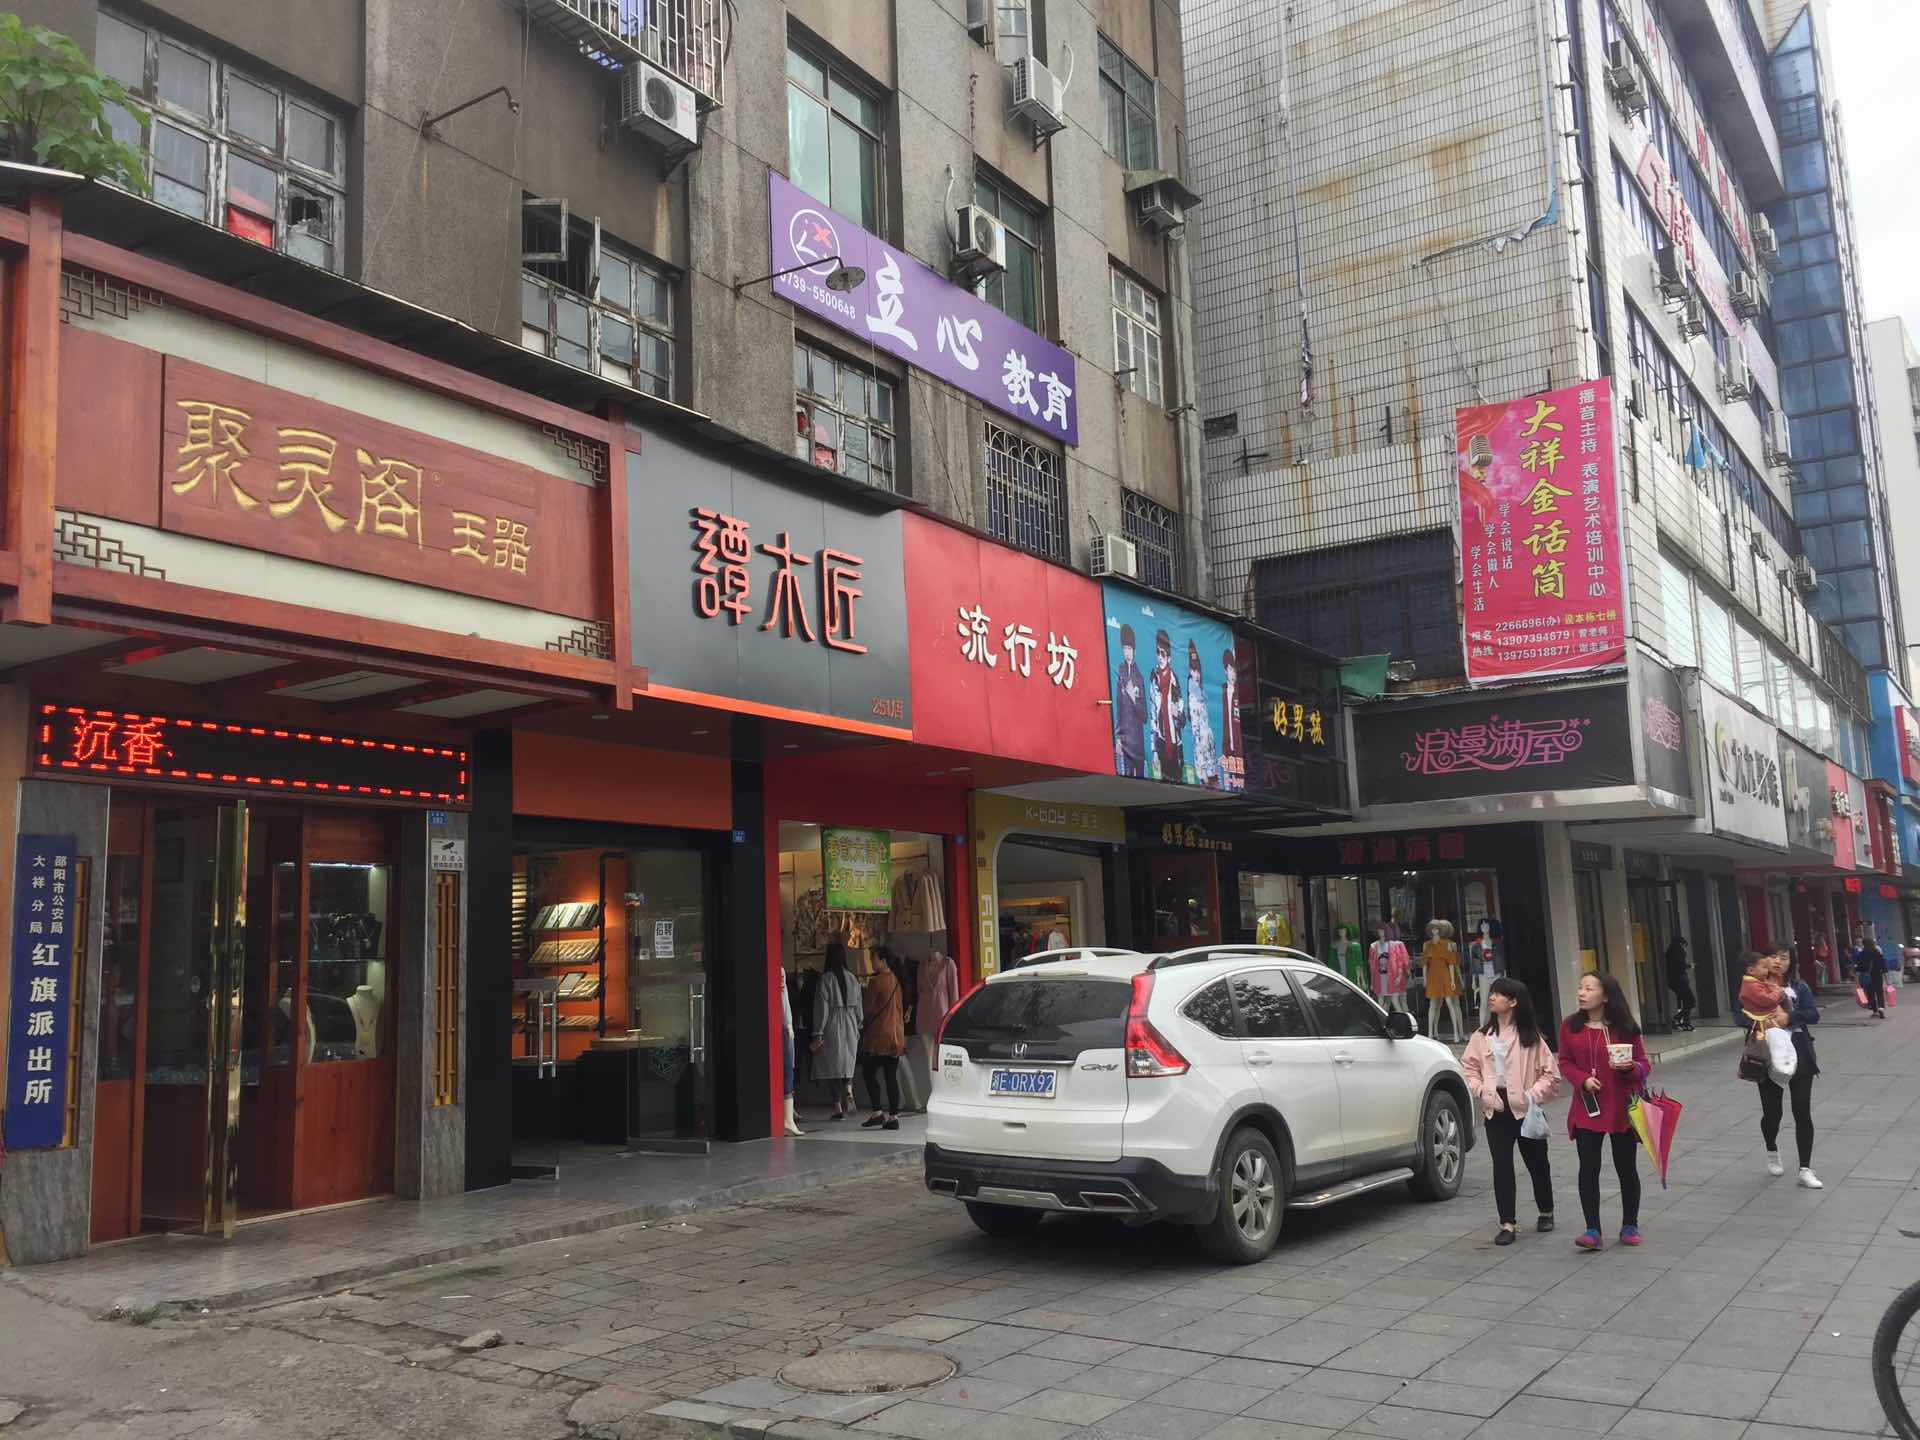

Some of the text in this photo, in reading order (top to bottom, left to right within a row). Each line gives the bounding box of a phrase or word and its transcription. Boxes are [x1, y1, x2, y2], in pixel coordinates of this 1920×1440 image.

[866, 251, 1072, 431] 立心教育
[171, 399, 425, 550] 聚灵阁
[1519, 399, 1573, 600] 大祥金话筒
[1578, 388, 1606, 598] 播音主持 表演艺术培训中心
[450, 511, 532, 577] 玉器
[1484, 522, 1499, 592] 学会做人
[1499, 502, 1513, 572] 学会说话
[1470, 544, 1485, 613] 学会生活
[957, 604, 1078, 690] 流行坊
[1400, 712, 1592, 776] 浪漫满屋
[29, 855, 46, 935] 大祥分局
[50, 855, 67, 935] 邵阳市公安局
[24, 942, 60, 1105] 红旗派出所
